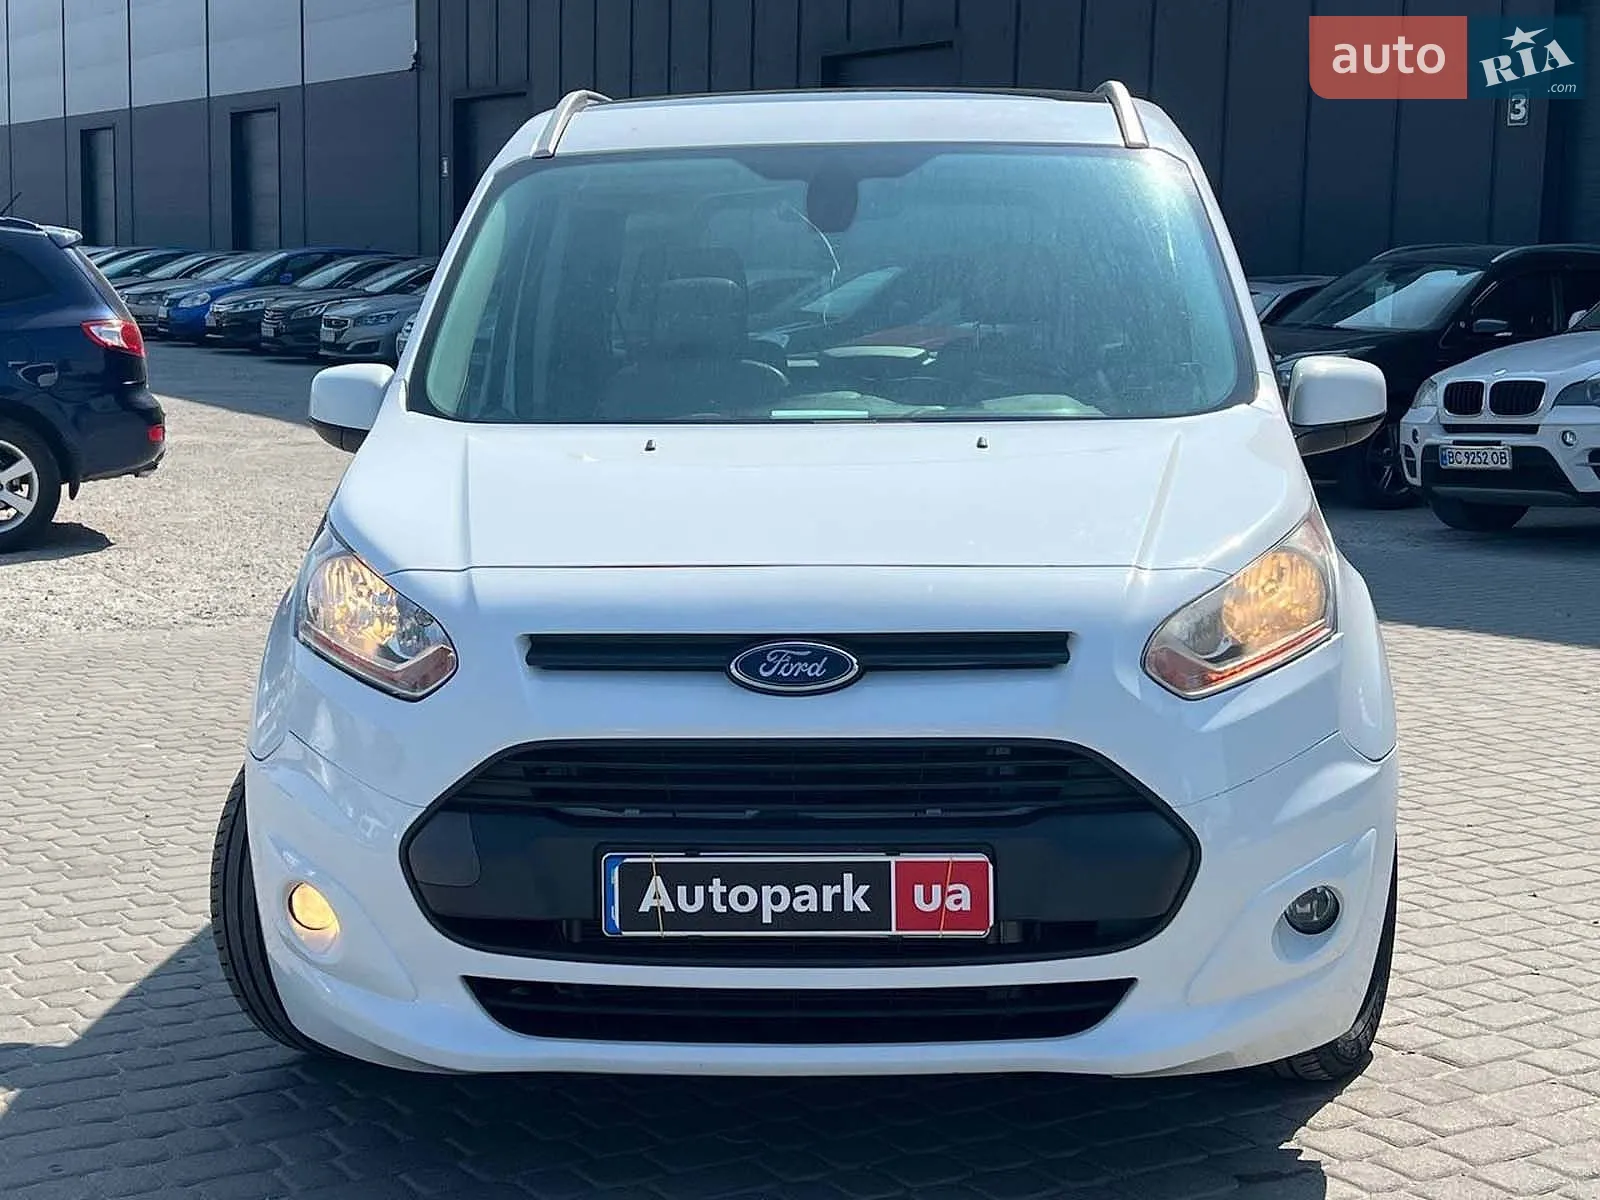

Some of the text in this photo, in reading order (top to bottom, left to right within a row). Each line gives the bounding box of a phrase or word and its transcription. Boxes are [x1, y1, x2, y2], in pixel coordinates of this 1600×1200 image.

[1511, 94, 1526, 120] 3
[1447, 451, 1508, 465] BC 9252 OB
[759, 649, 828, 677] Ford
[638, 873, 971, 923] Autopark ua
